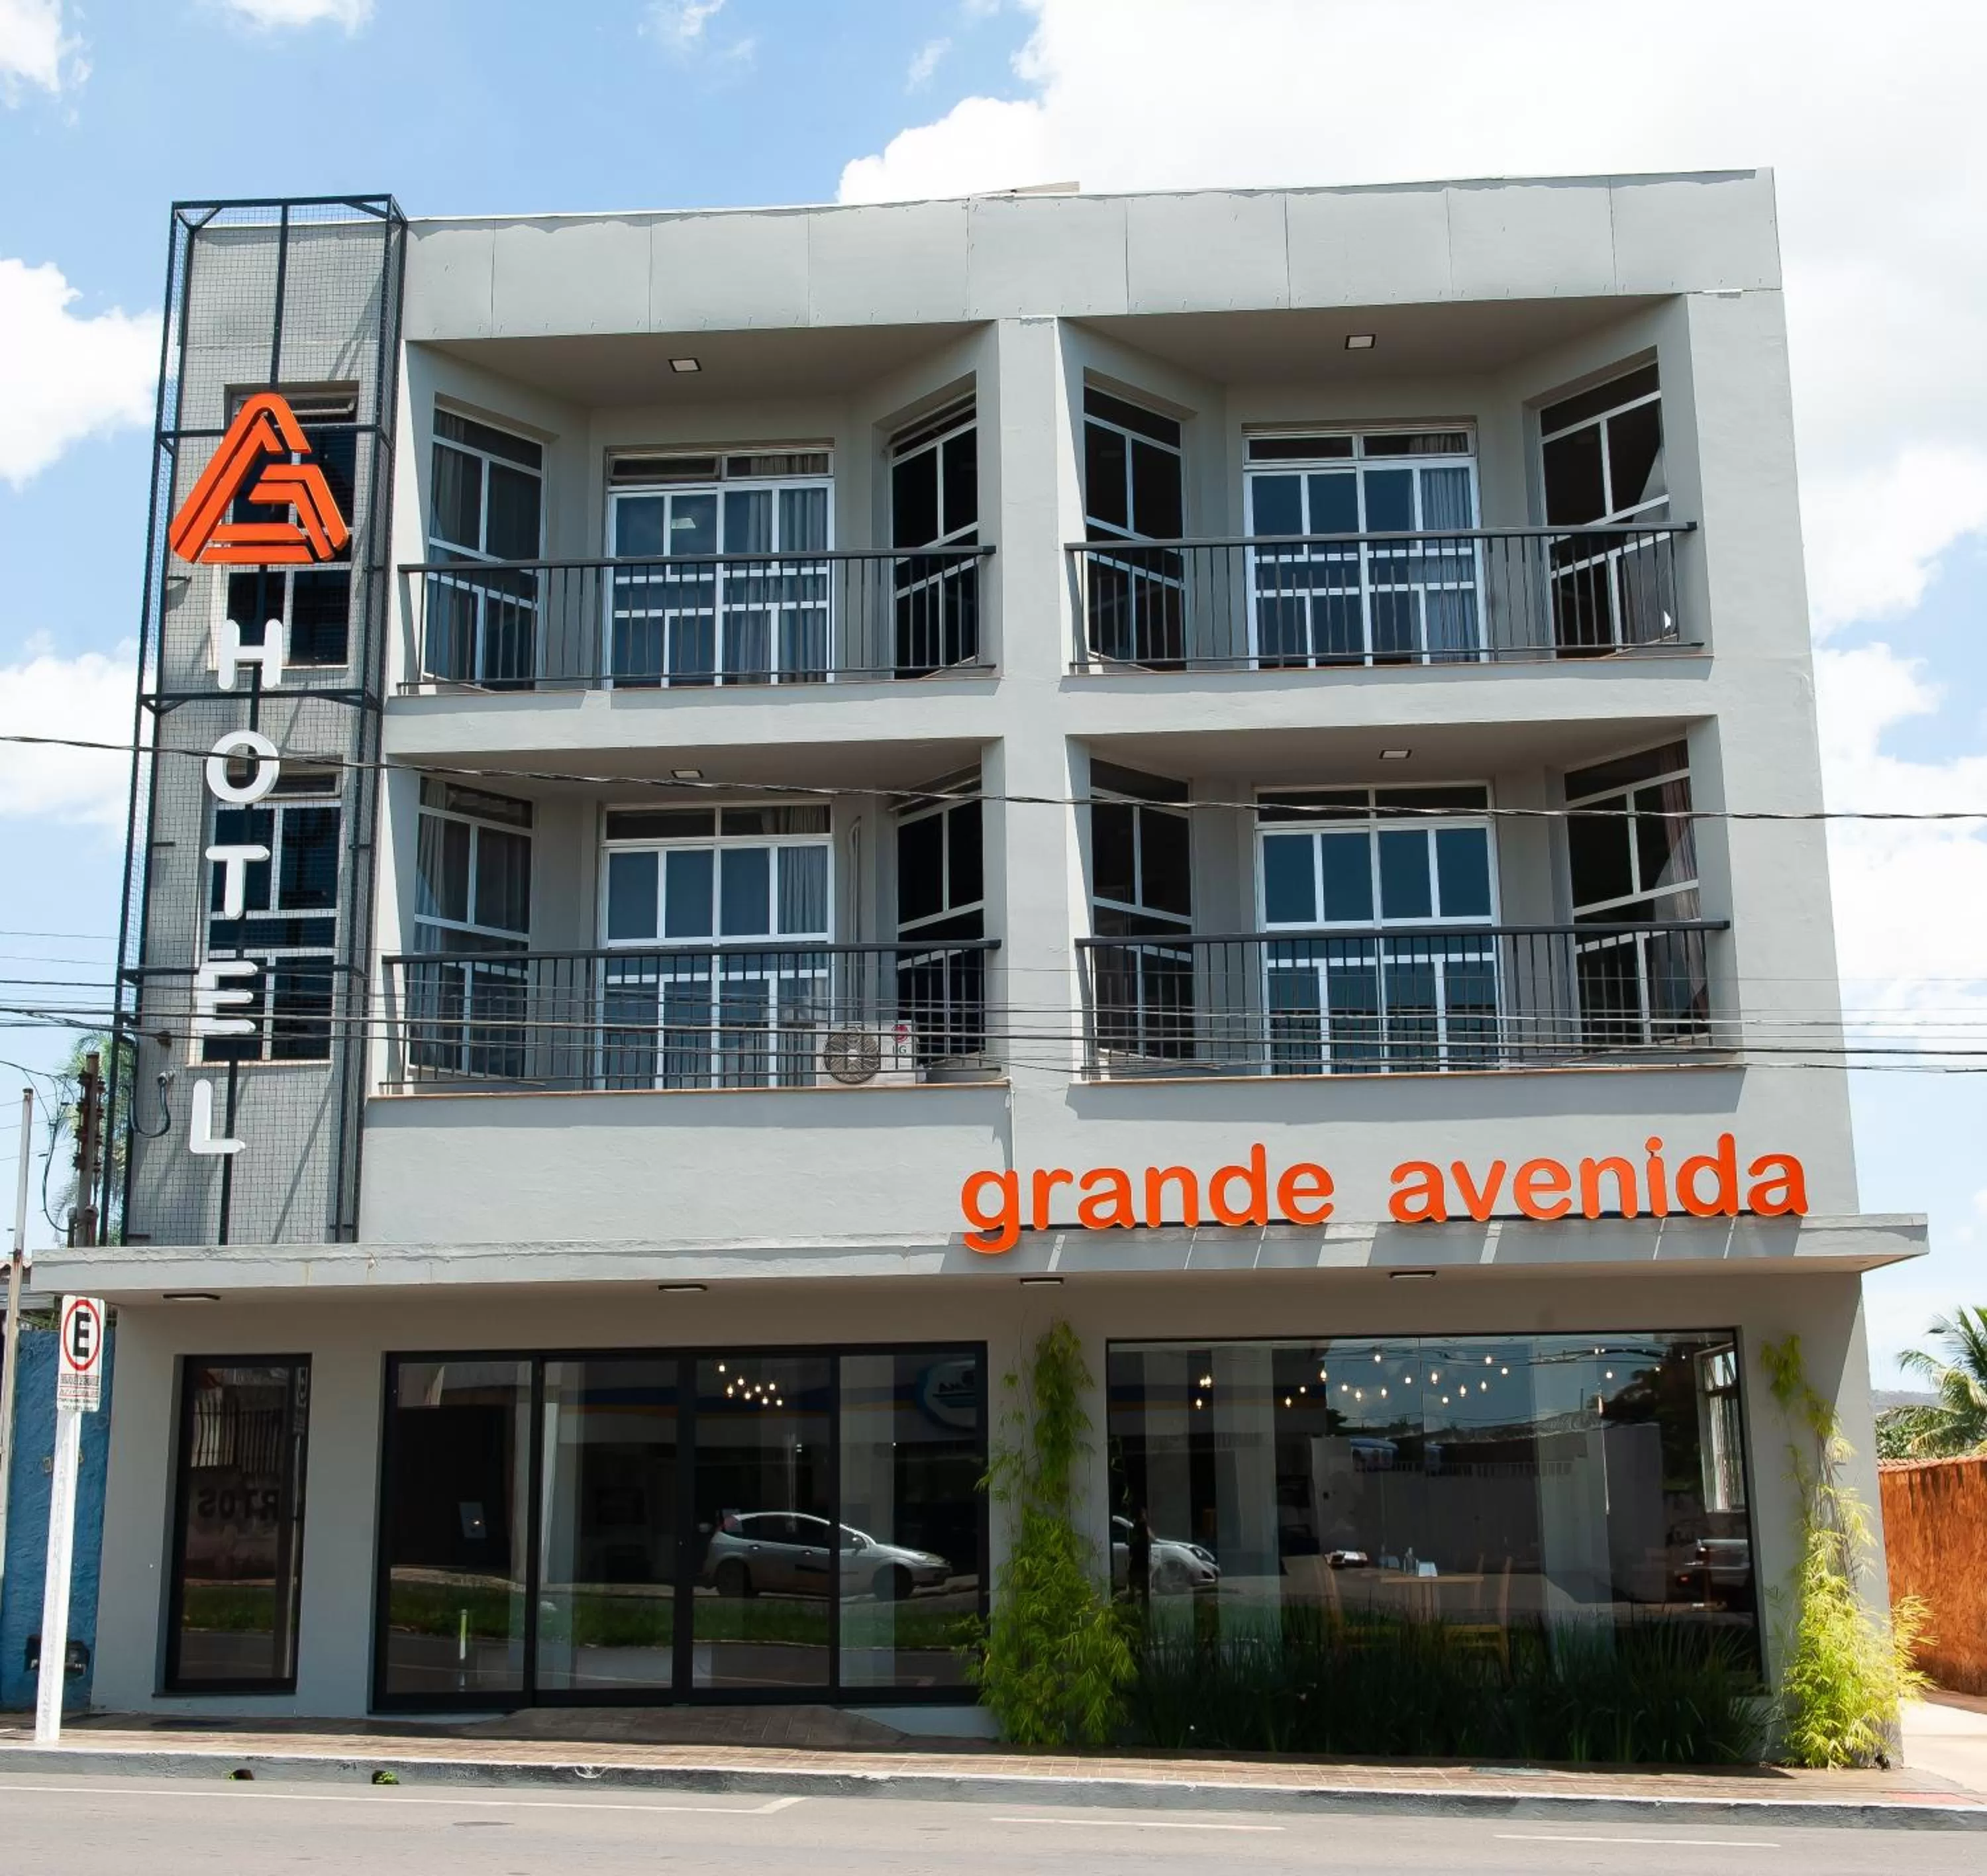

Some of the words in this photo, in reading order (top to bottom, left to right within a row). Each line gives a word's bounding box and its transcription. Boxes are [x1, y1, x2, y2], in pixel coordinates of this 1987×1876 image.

[189, 618, 283, 1155] HOTEL
[961, 1143, 1335, 1253] grande
[1388, 1131, 1809, 1223] avenida
[73, 1311, 91, 1358] E
